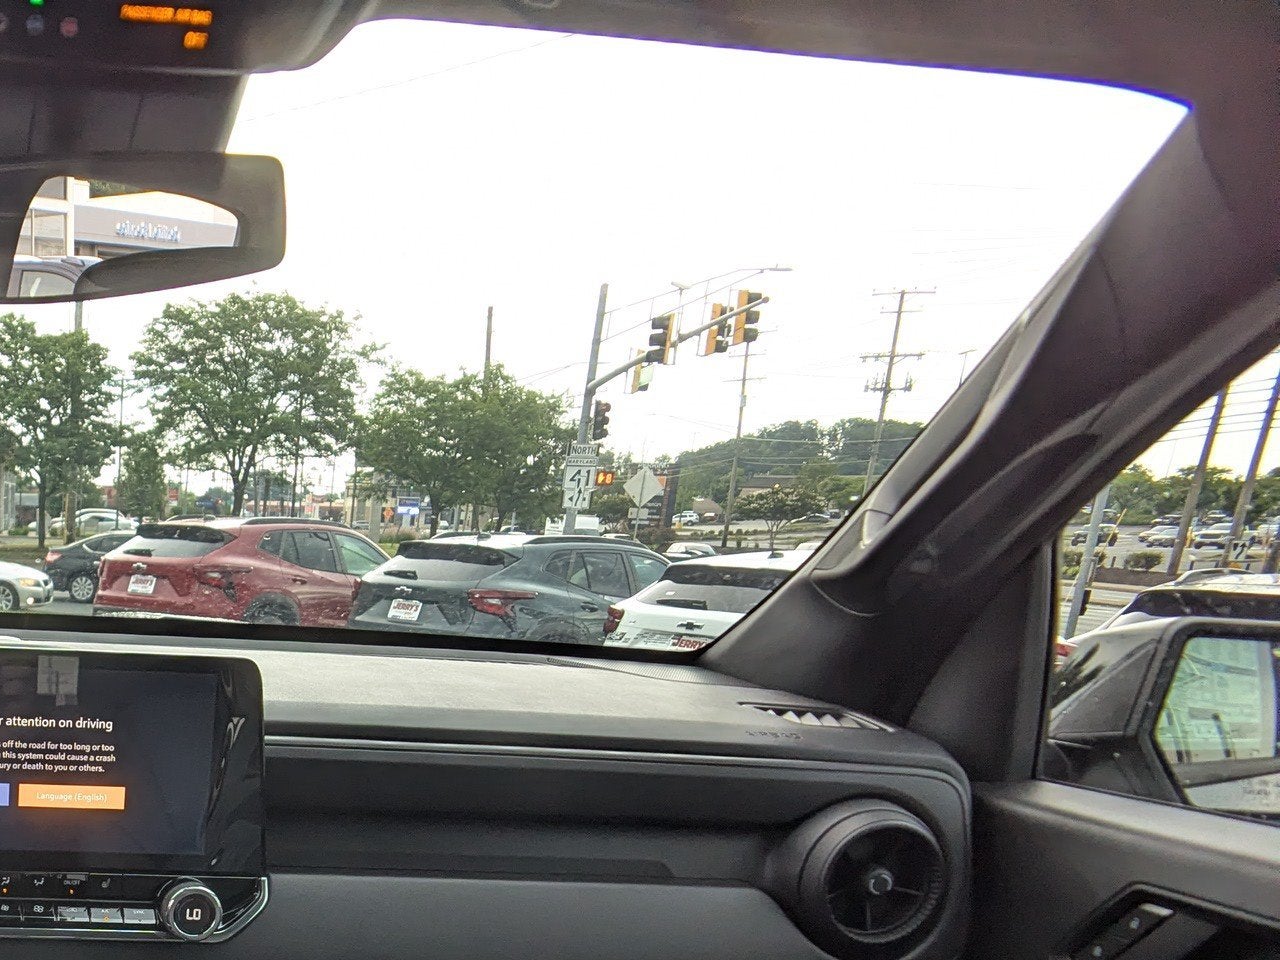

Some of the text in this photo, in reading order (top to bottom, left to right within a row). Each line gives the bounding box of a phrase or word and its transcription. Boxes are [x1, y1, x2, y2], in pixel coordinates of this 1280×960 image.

[572, 446, 596, 455] NORTH
[5, 715, 56, 728] attention
[58, 719, 73, 728] on
[75, 717, 113, 732] driving
[2, 740, 15, 748] off
[14, 740, 27, 749] the
[28, 741, 46, 750] road
[47, 741, 59, 750] for
[73, 742, 91, 753] long
[101, 743, 115, 752] too
[2, 750, 16, 759] this
[17, 752, 44, 761] system
[44, 752, 66, 760] could
[95, 754, 116, 762] crash
[21, 762, 44, 770] death
[78, 763, 105, 772] others.
[36, 792, 108, 803] Language (English)
[186, 908, 202, 920] LO
